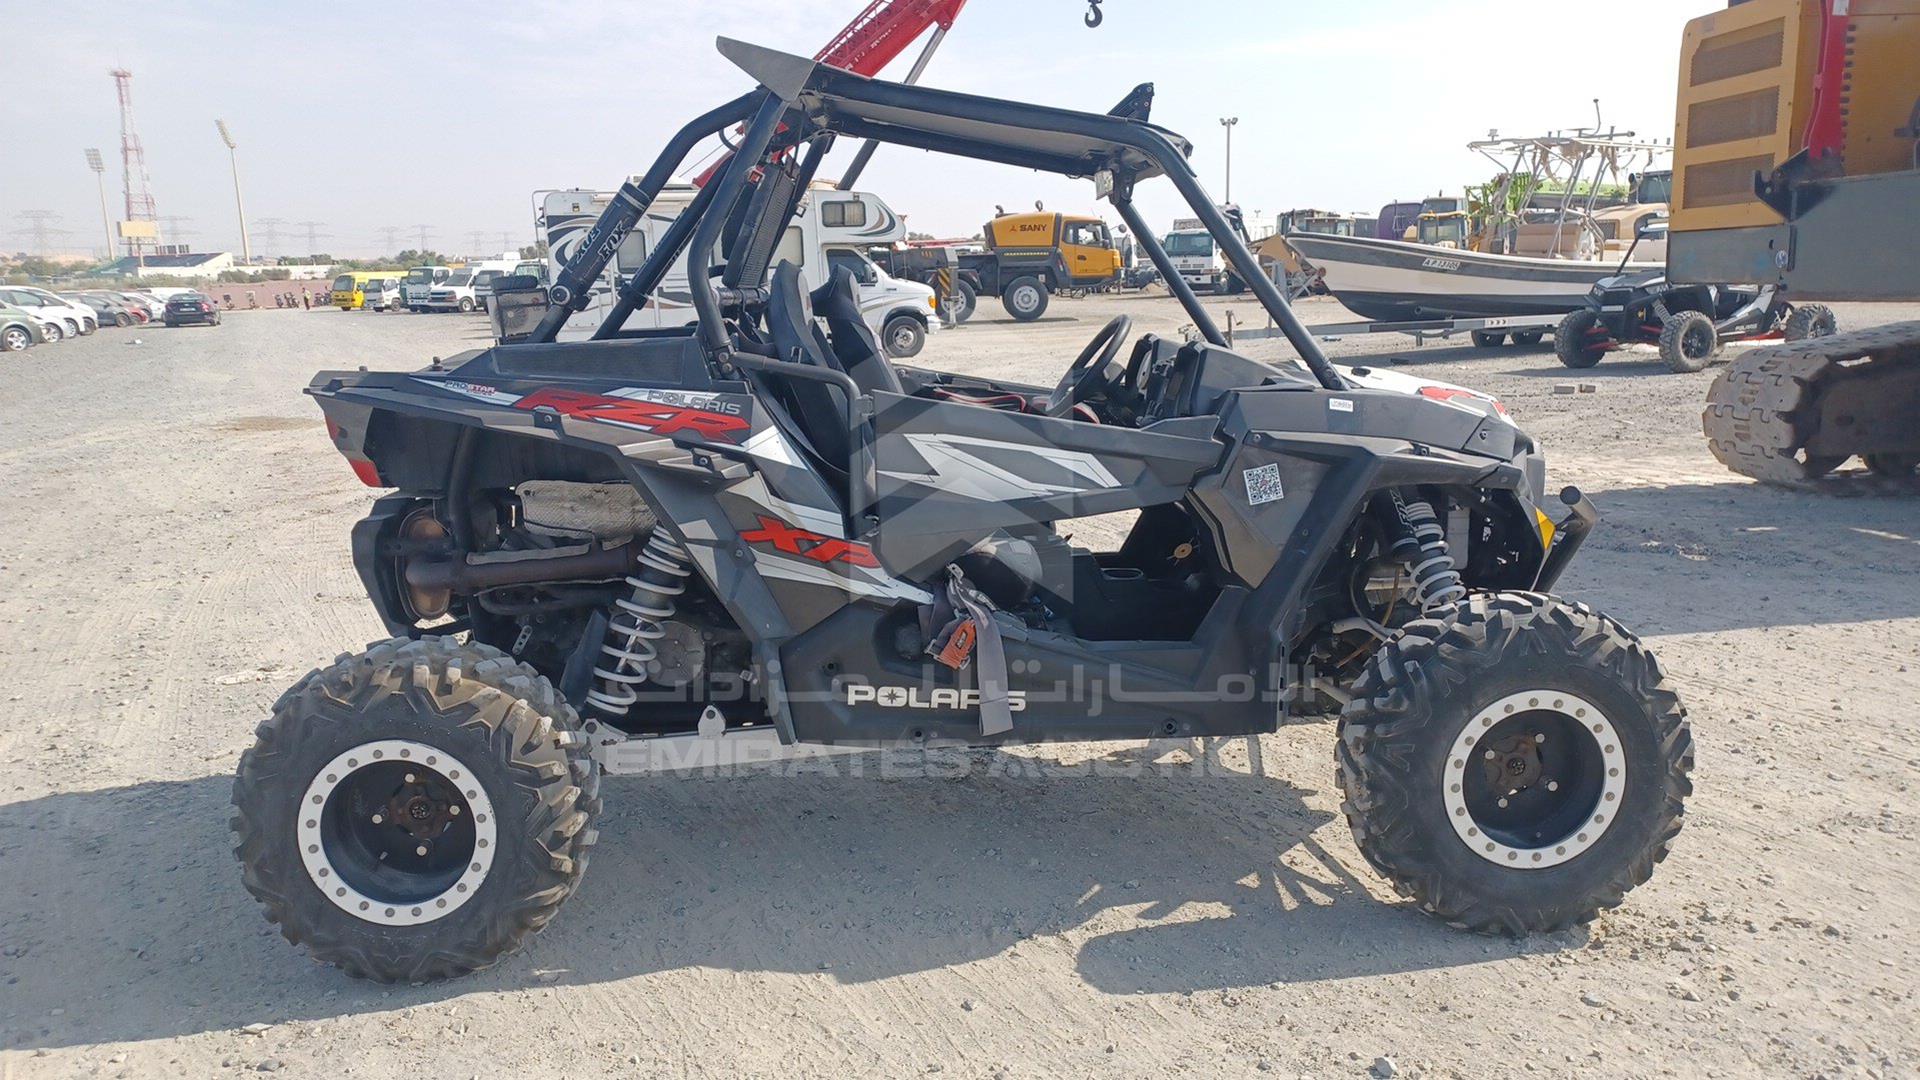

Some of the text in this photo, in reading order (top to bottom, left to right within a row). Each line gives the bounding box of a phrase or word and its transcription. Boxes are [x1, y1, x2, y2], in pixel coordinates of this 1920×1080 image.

[597, 218, 631, 261] FOX
[1020, 224, 1047, 232] SANY
[647, 389, 741, 415] POLARIS
[739, 514, 882, 569] XP
[848, 685, 1026, 711] POLARS
